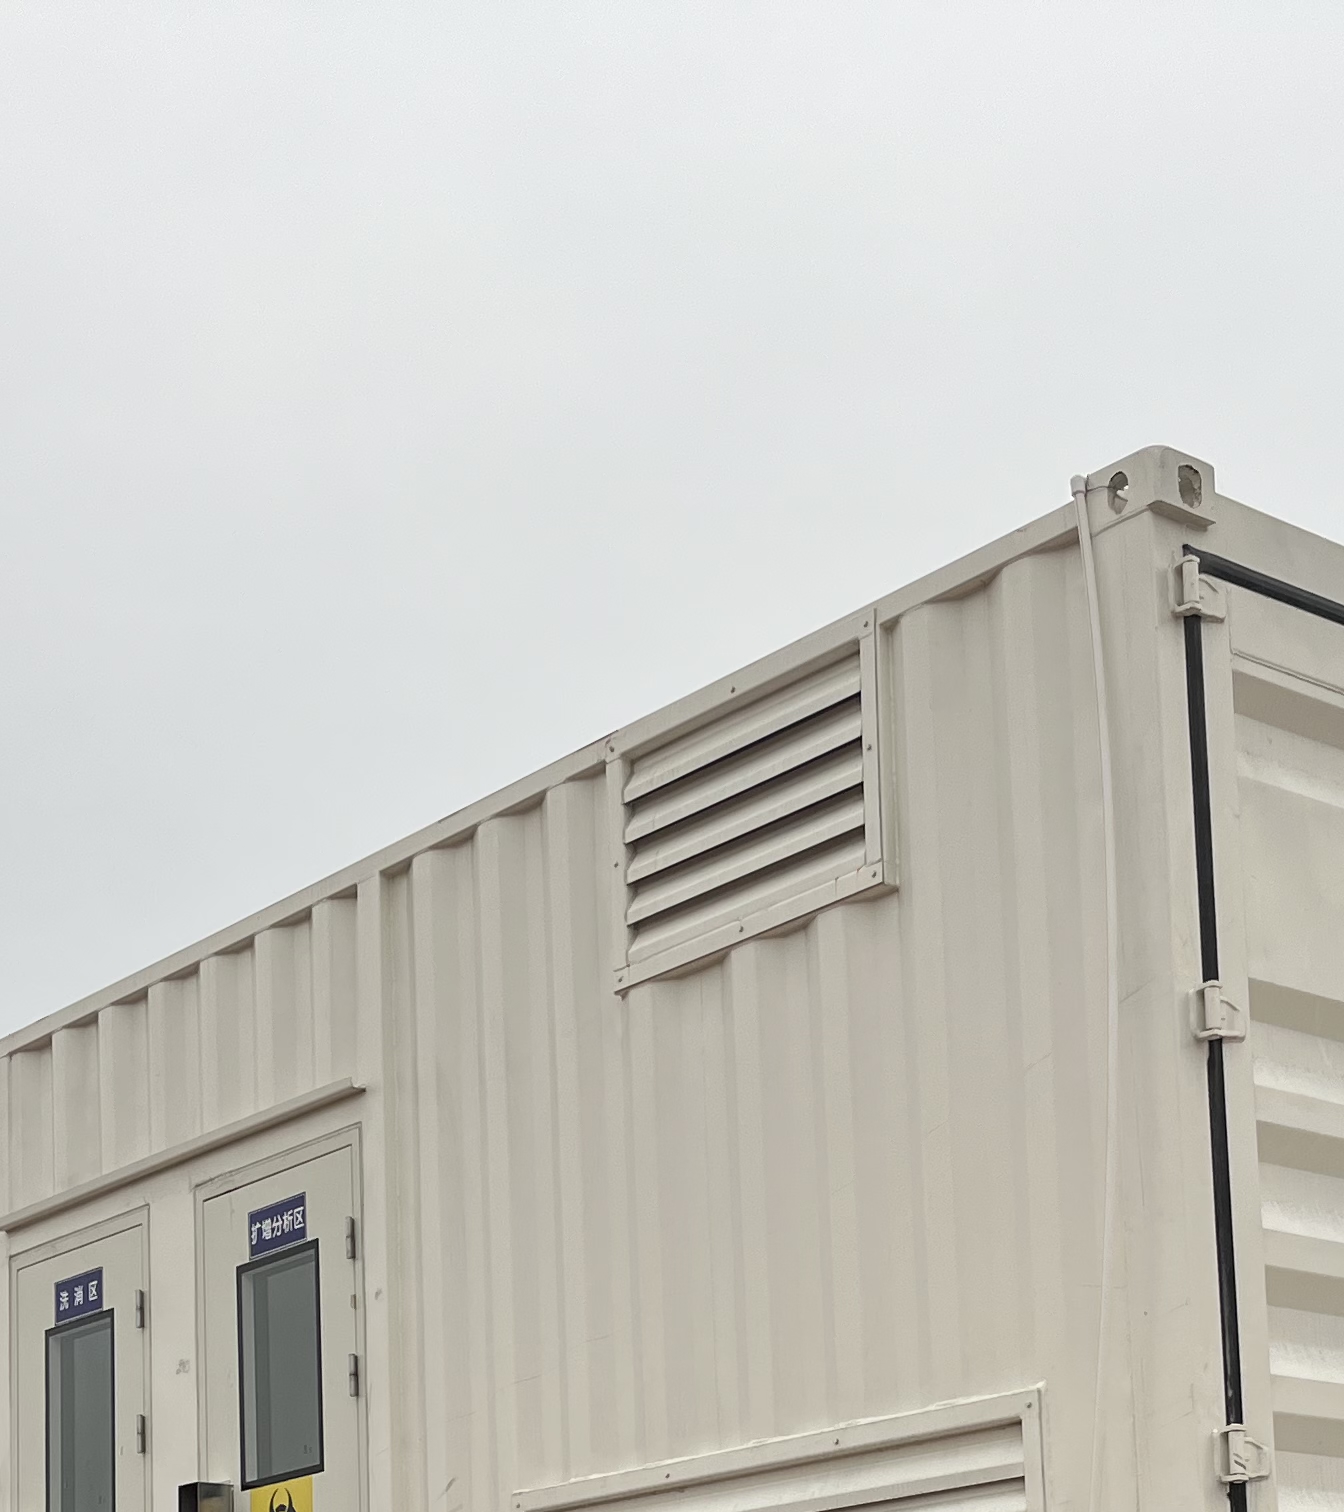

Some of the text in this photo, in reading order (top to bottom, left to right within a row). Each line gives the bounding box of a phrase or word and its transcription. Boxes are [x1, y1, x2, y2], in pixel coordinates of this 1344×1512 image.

[251, 1206, 304, 1245] 扩增分析区
[59, 1280, 98, 1311] 洗消区
